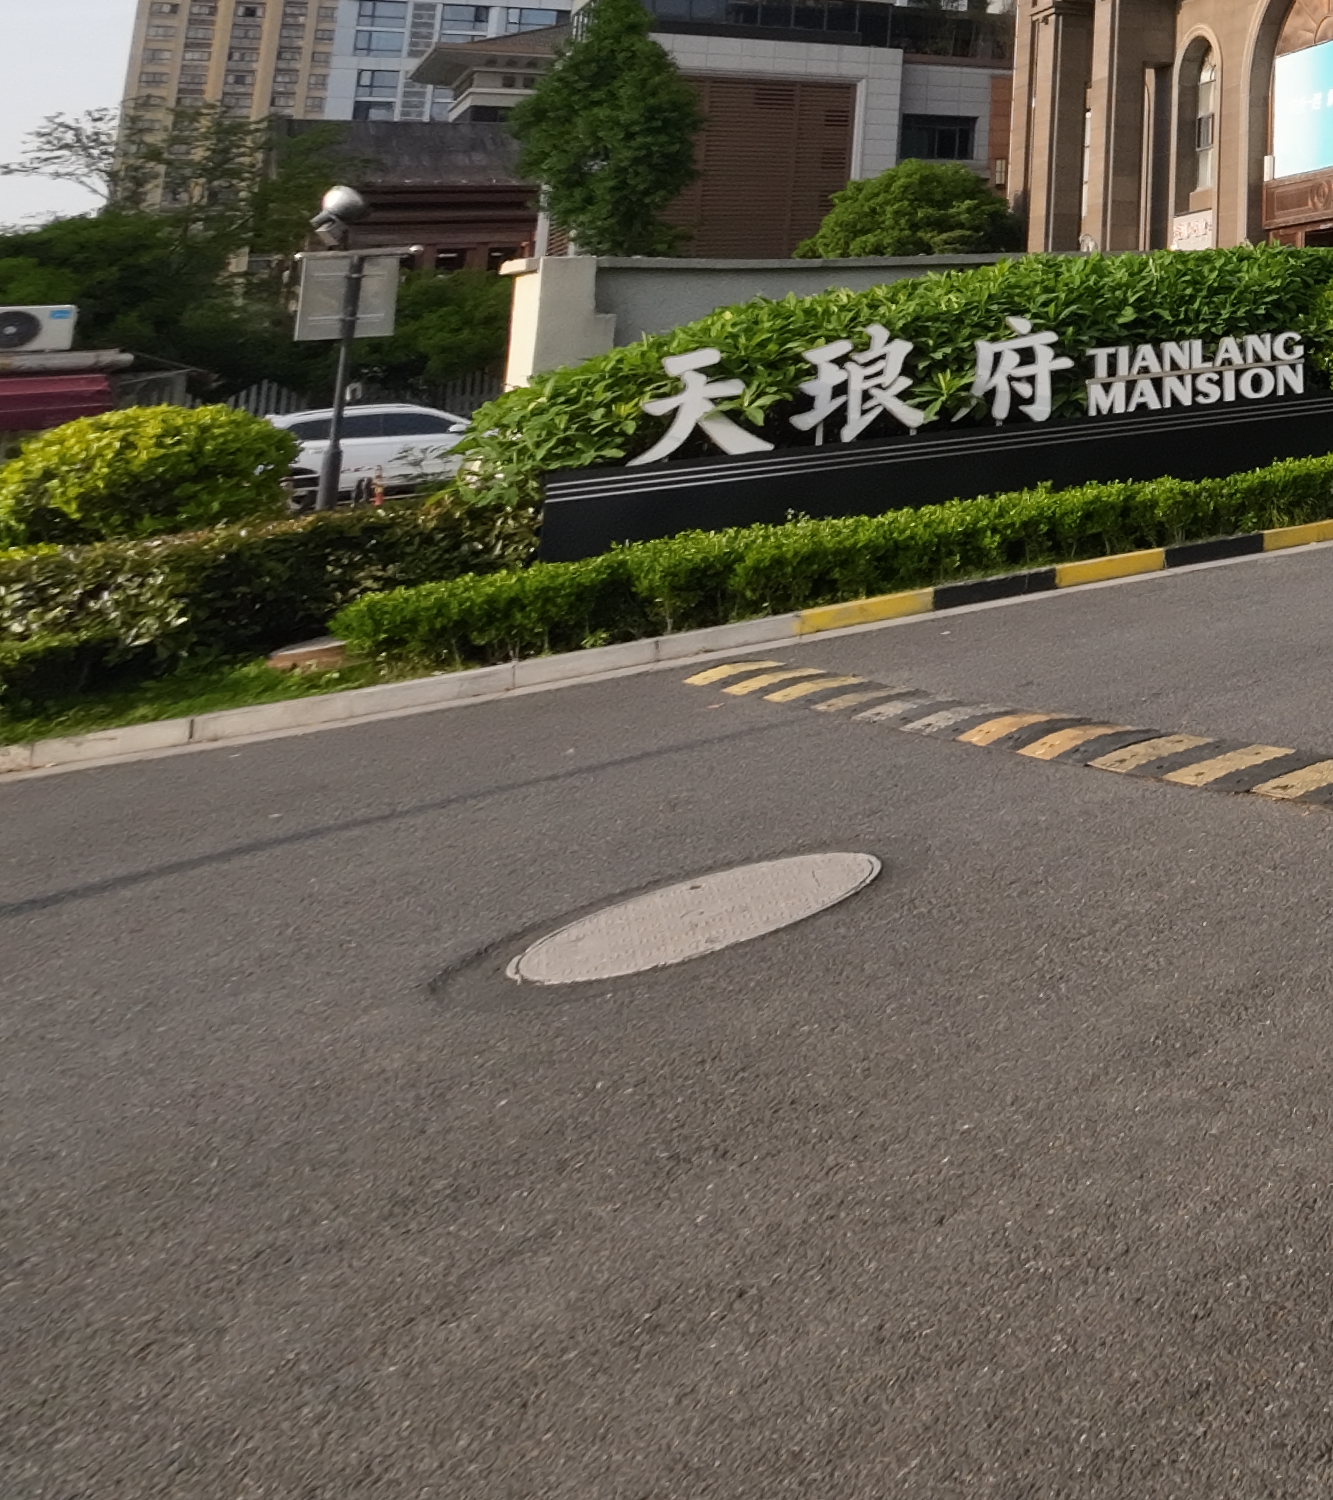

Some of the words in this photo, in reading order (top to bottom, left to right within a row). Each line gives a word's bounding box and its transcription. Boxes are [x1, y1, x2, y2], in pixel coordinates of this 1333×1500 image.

[1086, 331, 1305, 379] TIANLANG
[625, 316, 1075, 467] 天琅府
[1087, 363, 1305, 417] MANSION
